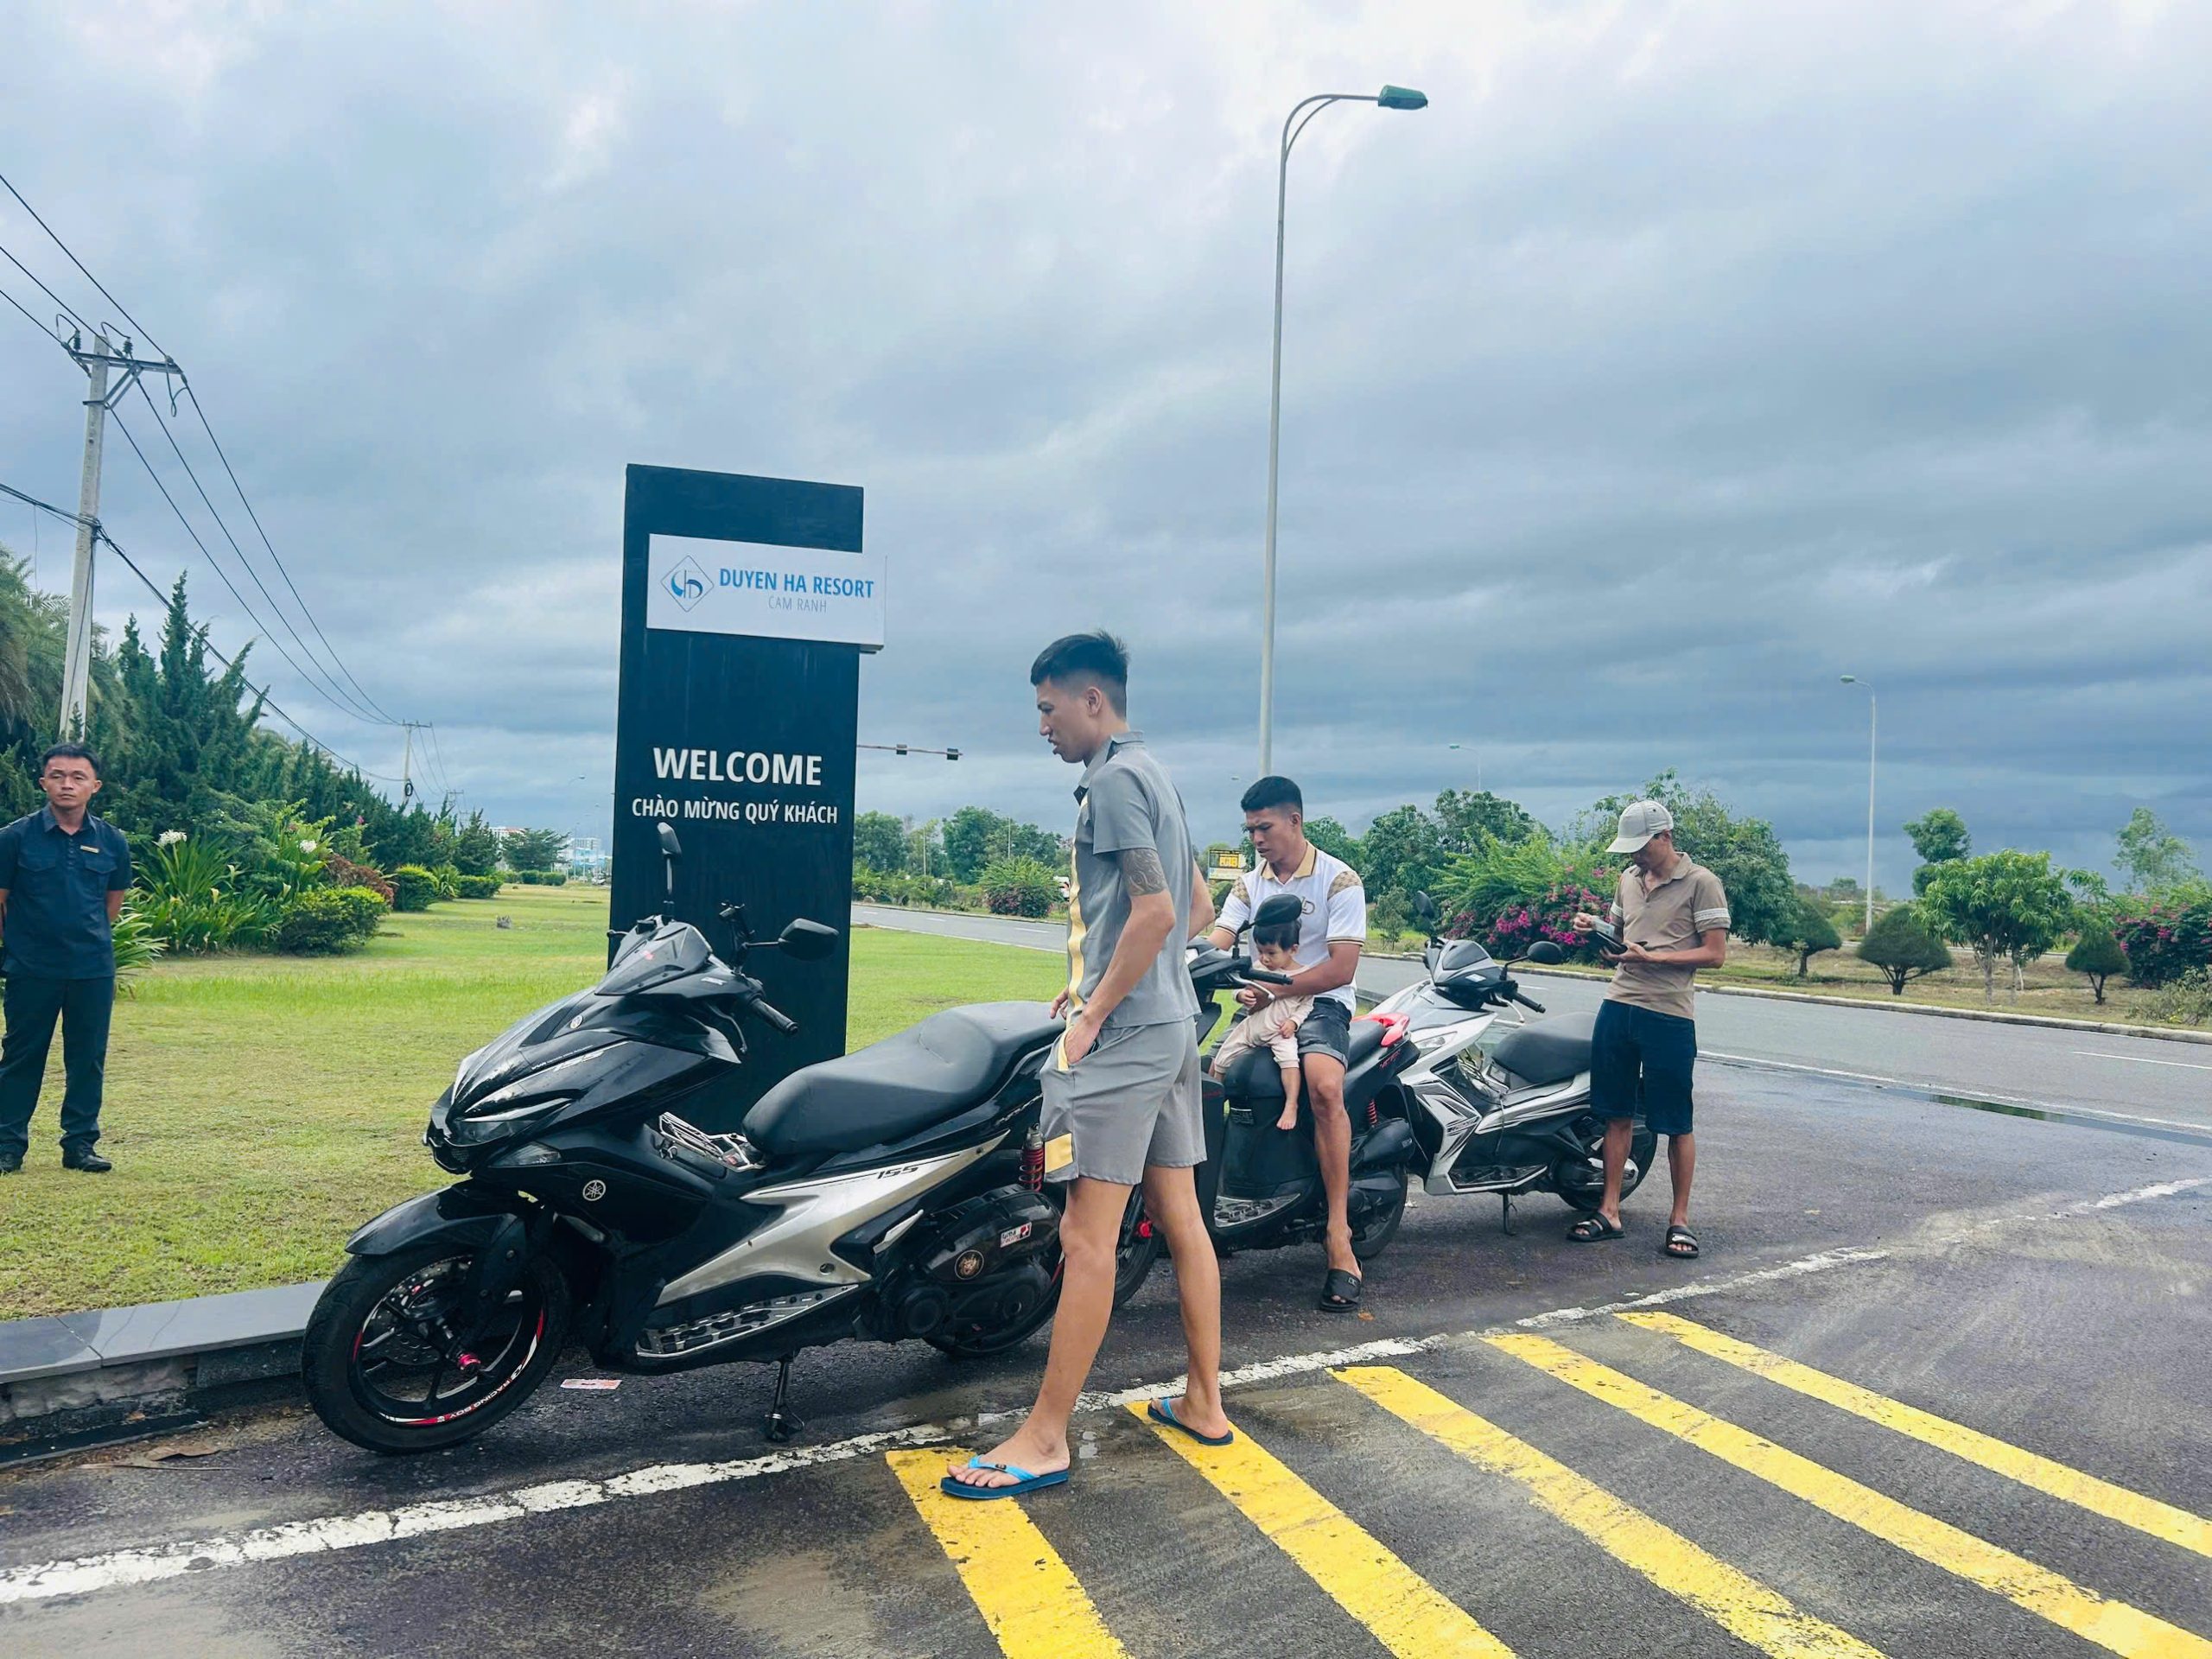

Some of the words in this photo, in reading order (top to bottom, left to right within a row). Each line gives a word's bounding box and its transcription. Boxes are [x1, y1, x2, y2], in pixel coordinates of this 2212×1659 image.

[719, 568, 778, 591] DUYEN
[784, 574, 807, 593] HA
[813, 576, 874, 598] RESORT
[768, 595, 792, 611] CAM
[797, 598, 827, 613] RANH
[652, 747, 823, 785] WELCOME
[632, 794, 678, 817] CHÀO
[684, 796, 740, 820] MỪNG
[745, 798, 779, 824] QUÝ
[785, 800, 838, 823] KHÁCH
[877, 1166, 918, 1179] 155
[474, 1380, 511, 1408] RACING
[449, 1406, 472, 1419] BOY
